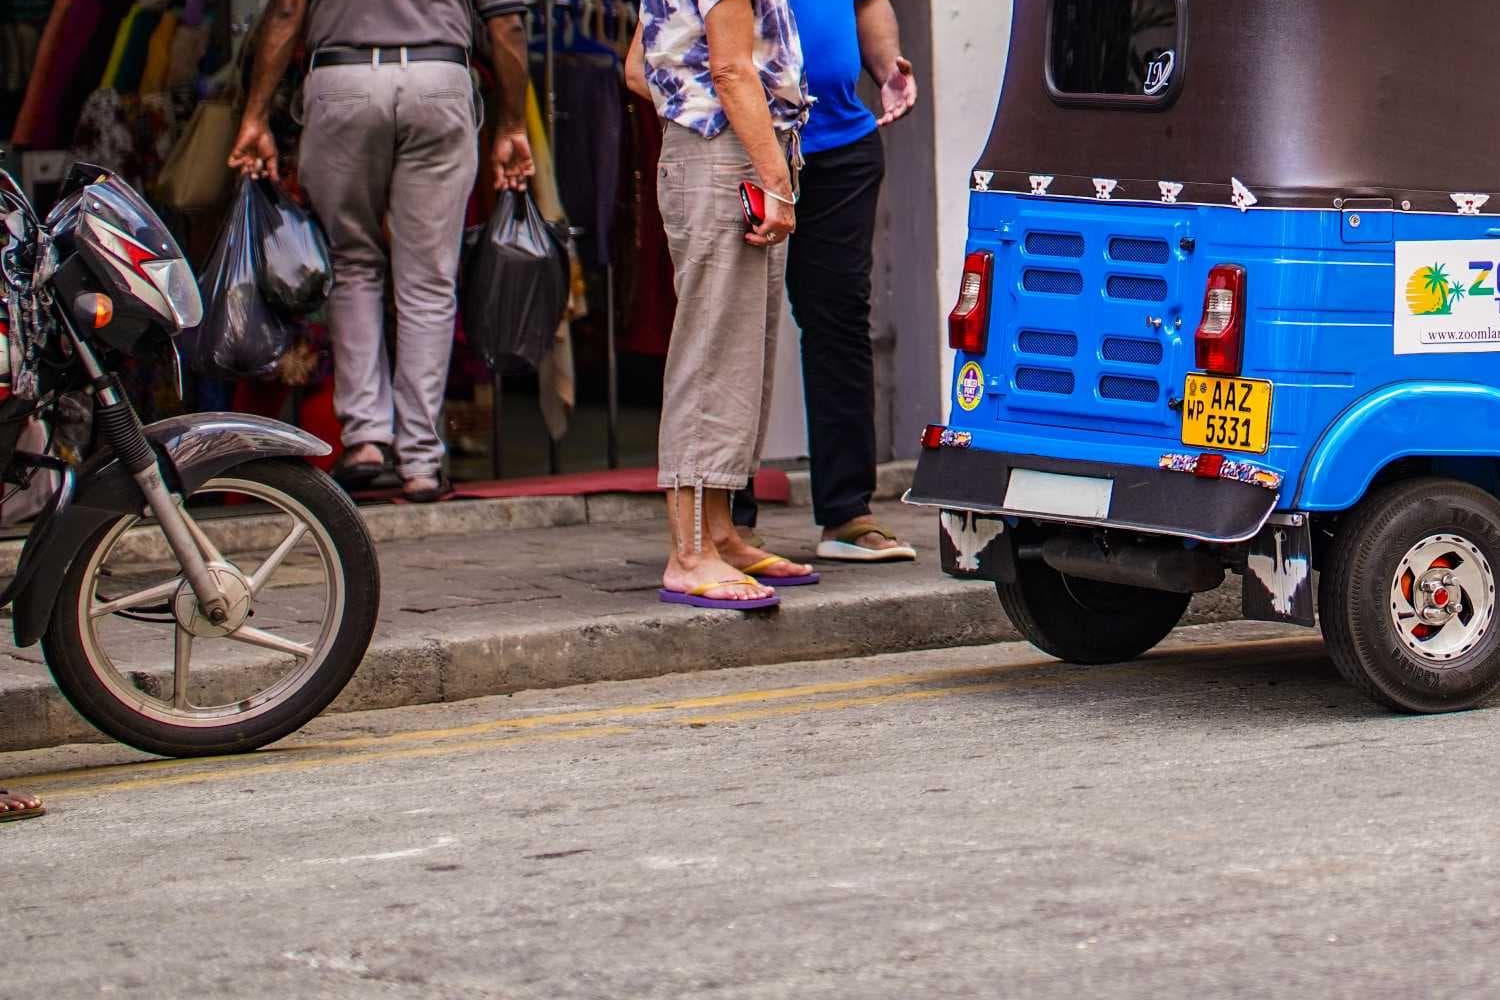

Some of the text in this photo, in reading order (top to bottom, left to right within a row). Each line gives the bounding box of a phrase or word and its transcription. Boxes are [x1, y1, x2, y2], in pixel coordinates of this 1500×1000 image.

[1187, 399, 1205, 421] WP
[1211, 381, 1254, 413] AAZ
[1205, 414, 1252, 447] 5331
